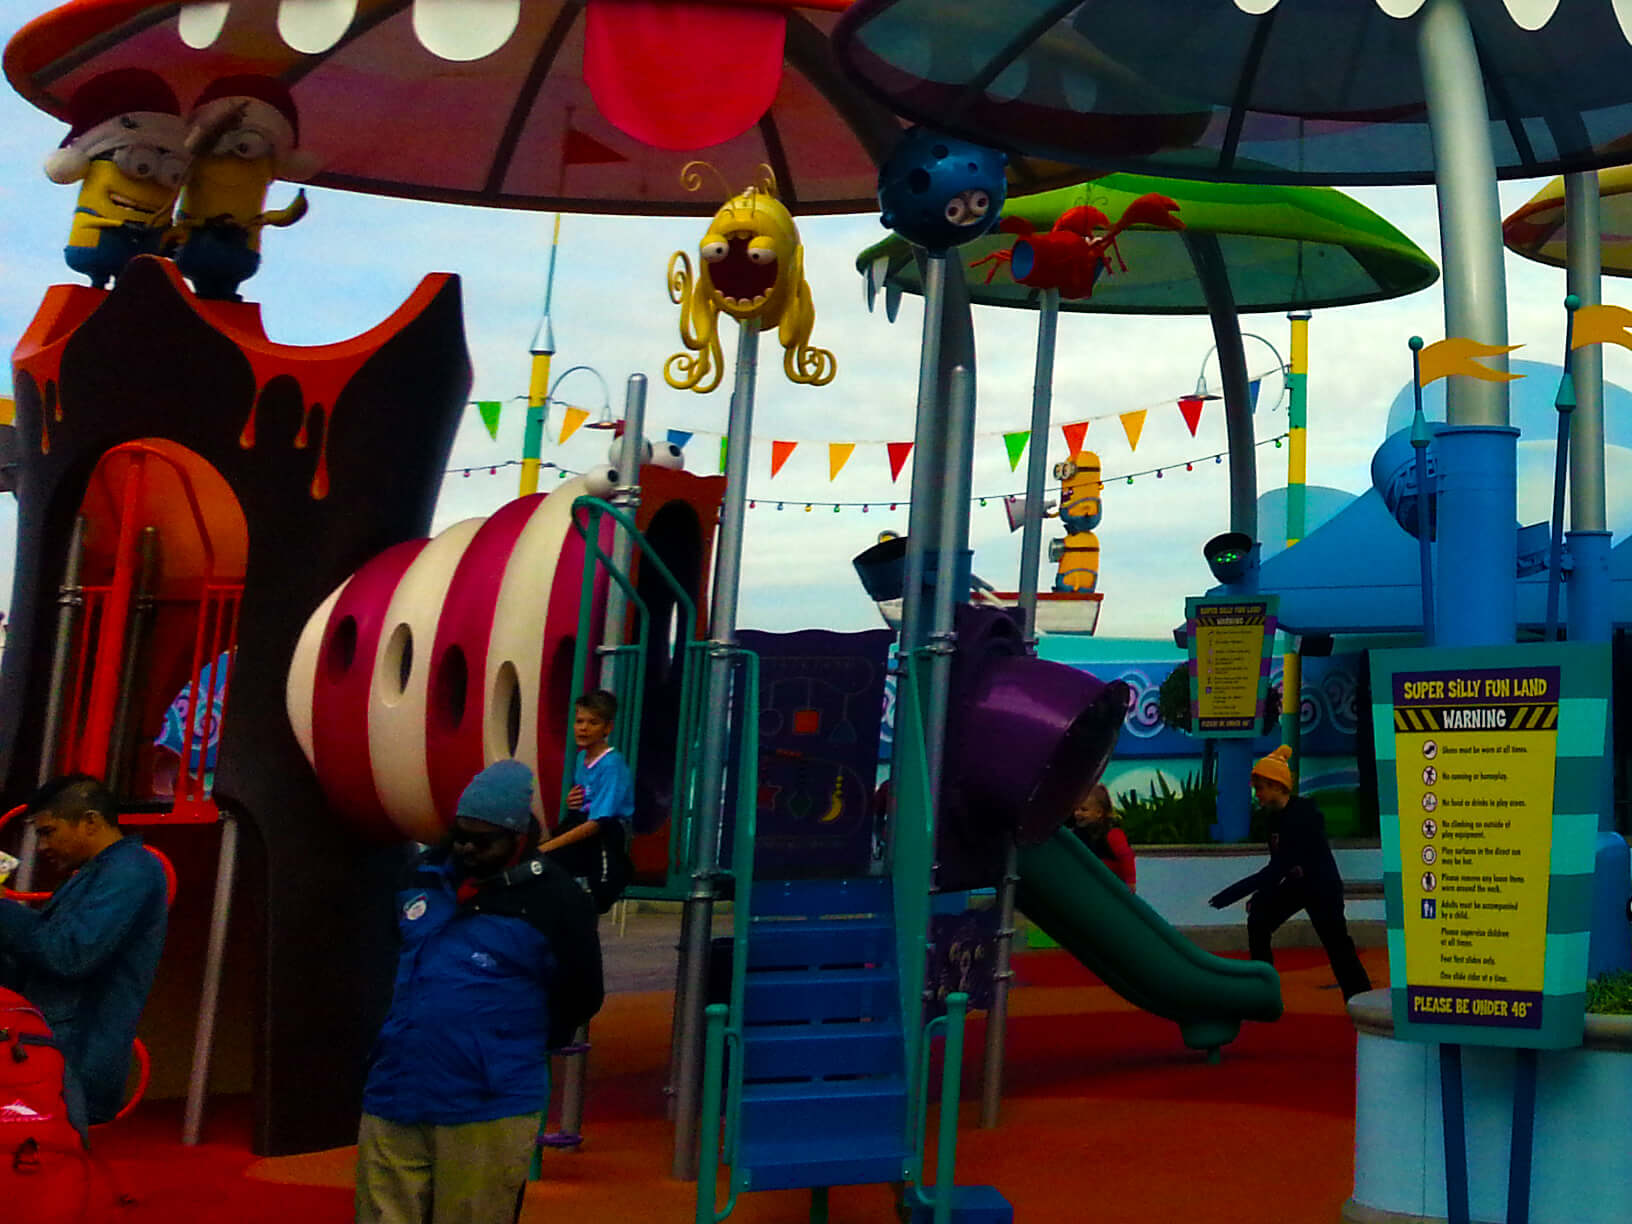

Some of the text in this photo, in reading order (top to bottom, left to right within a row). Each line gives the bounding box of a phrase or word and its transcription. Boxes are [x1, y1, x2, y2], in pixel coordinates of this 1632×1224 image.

[1403, 680, 1445, 700] SUPER
[1484, 678, 1510, 697] FUN
[1513, 677, 1547, 697] LAND
[1442, 709, 1507, 729] WARNING
[1459, 745, 1472, 753] must
[1473, 745, 1480, 753] be
[1503, 744, 1511, 752] all
[1442, 771, 1449, 779] No
[1414, 996, 1453, 1014] PLEASE
[1455, 997, 1471, 1014] BE
[1471, 1000, 1508, 1016] UNDER
